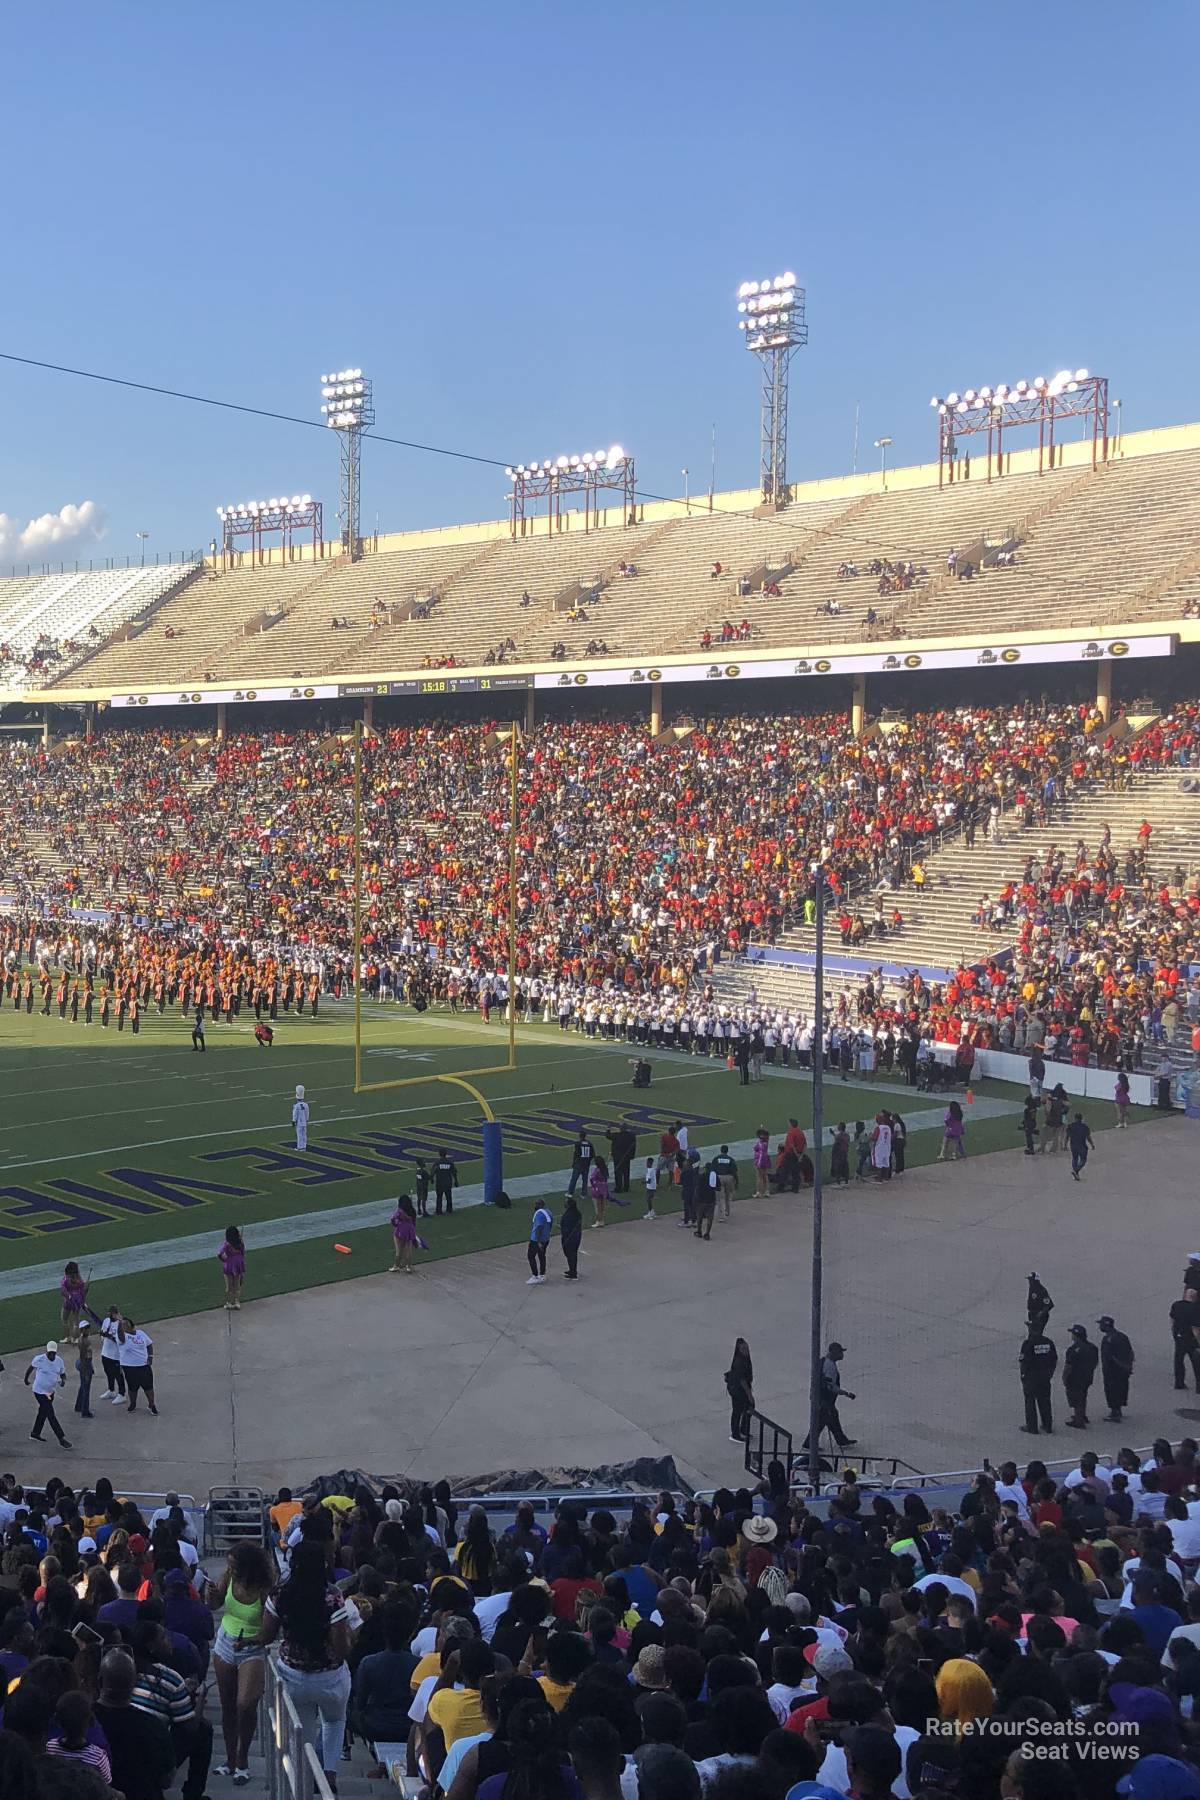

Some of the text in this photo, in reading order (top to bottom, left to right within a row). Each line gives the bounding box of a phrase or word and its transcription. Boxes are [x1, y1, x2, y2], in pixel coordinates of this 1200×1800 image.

[1107, 641, 1129, 656] G
[1001, 648, 1021, 662] G
[815, 660, 832, 672] G
[904, 655, 922, 668] G
[647, 670, 662, 681] G
[724, 665, 740, 678] G
[480, 680, 491, 689] 31
[574, 674, 588, 685] G
[377, 684, 388, 694] 23
[422, 682, 445, 692] 15:18
